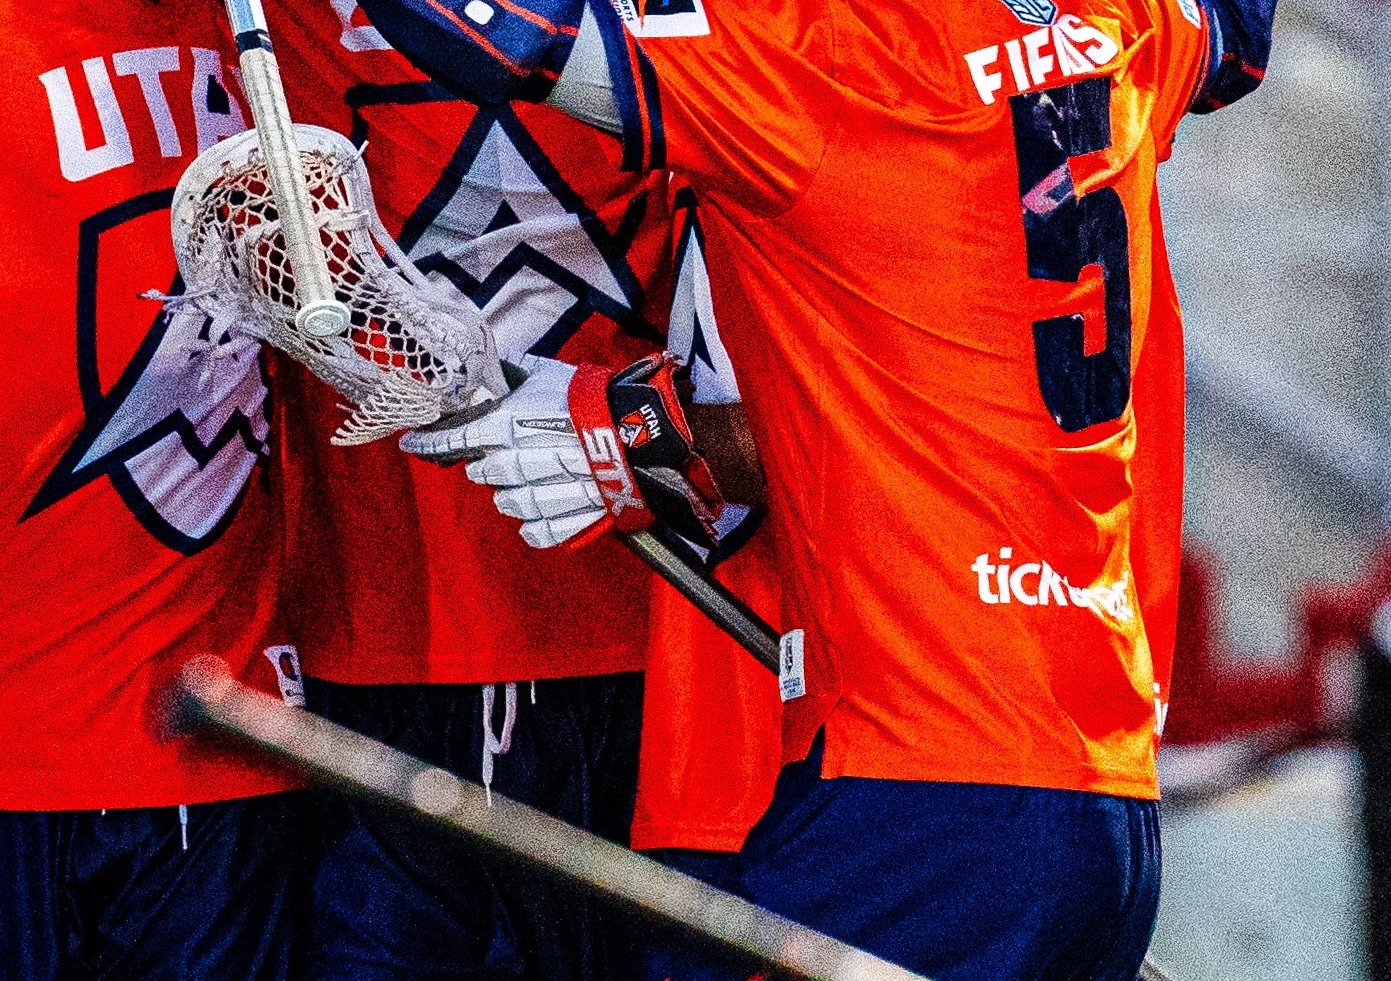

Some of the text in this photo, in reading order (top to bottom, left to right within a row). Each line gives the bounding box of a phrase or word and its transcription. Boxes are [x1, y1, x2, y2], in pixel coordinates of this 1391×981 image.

[37, 45, 250, 183] UTA
[1009, 75, 1133, 434] 5
[581, 425, 645, 517] STX
[639, 403, 662, 439] UTAH
